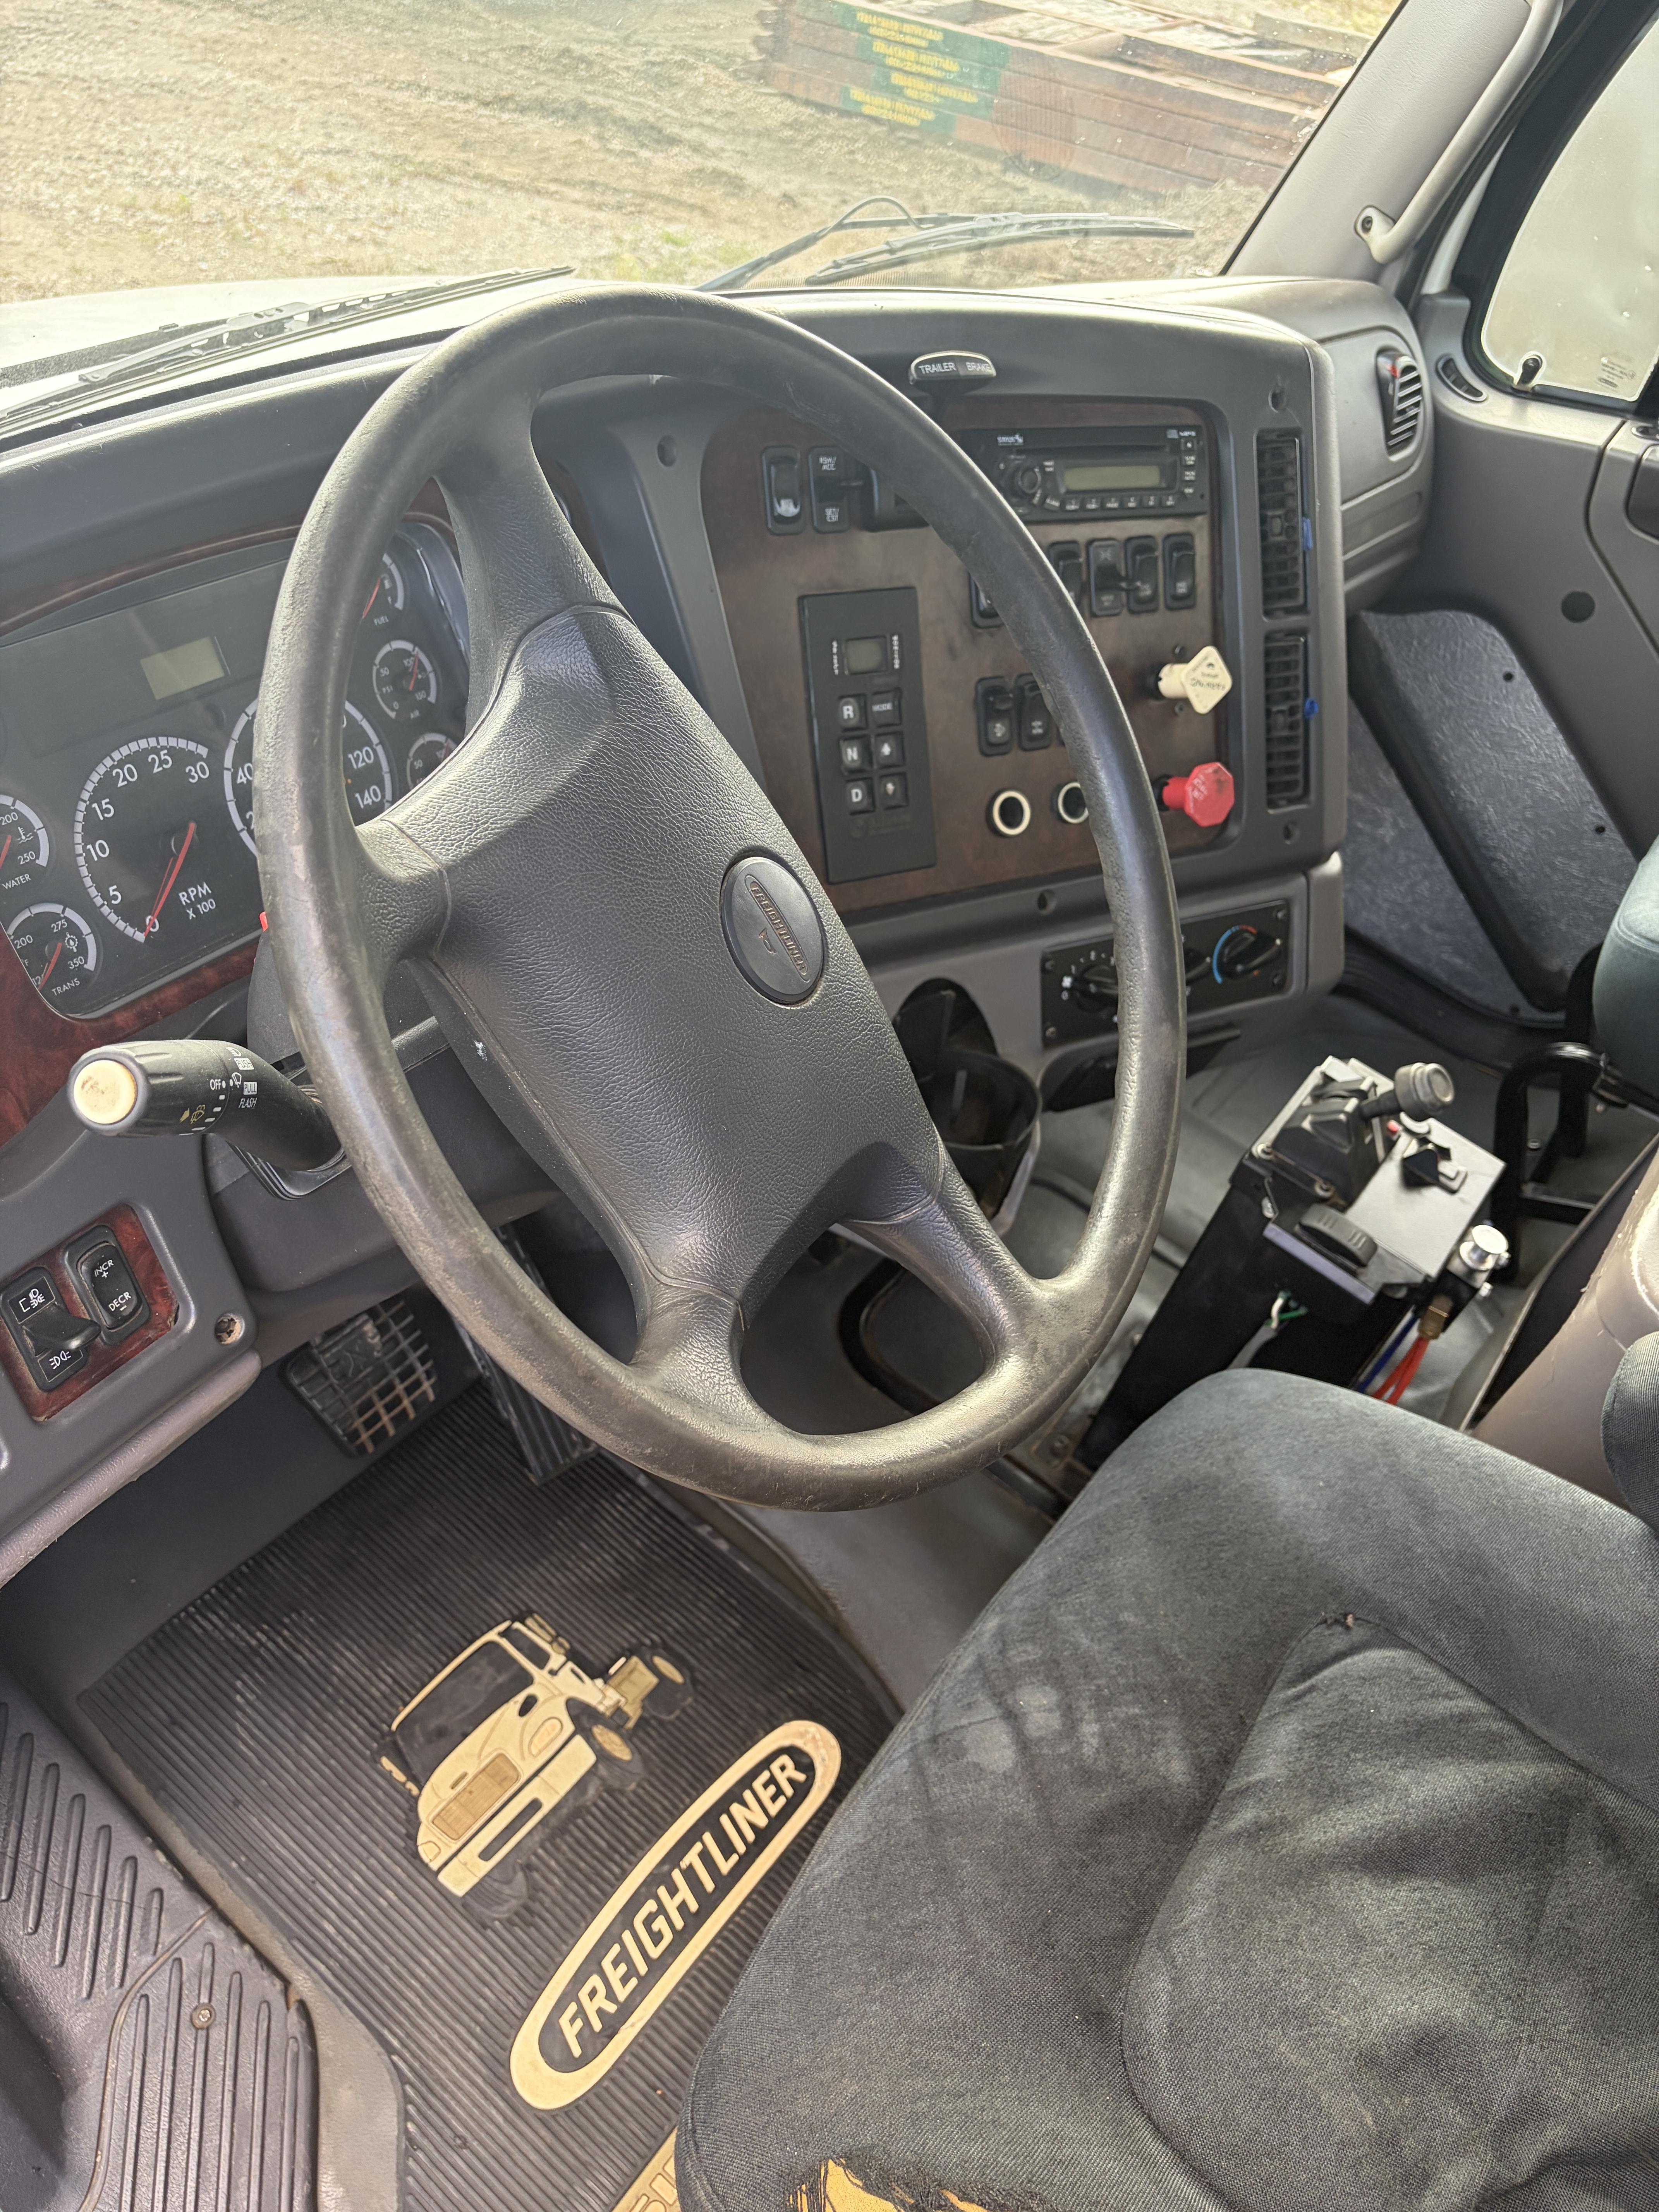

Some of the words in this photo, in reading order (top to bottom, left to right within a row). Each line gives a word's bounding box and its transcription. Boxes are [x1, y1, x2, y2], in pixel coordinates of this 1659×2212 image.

[918, 362, 957, 374] TRAILER
[966, 362, 992, 371] BRAKE
[393, 701, 399, 709] 0
[843, 705, 854, 719] R
[148, 750, 173, 774] 25
[349, 747, 374, 769] 120
[847, 747, 859, 761] N
[414, 759, 423, 769] 50
[113, 764, 138, 788] 20
[186, 762, 209, 783] 30
[236, 763, 253, 784] 40
[355, 785, 381, 809] 140
[852, 790, 862, 802] D
[92, 799, 114, 820] 15
[0, 812, 18, 826] 200
[18, 851, 35, 864] 250
[86, 840, 109, 861] 10
[2, 874, 31, 890] WATER
[109, 886, 121, 904] 5
[179, 882, 212, 905] RPM
[187, 909, 196, 920] X
[197, 899, 216, 915] 100
[51, 919, 67, 933] 275
[146, 915, 159, 932] 0
[750, 887, 807, 971] FREIGHTLINER
[14, 935, 33, 949] 200
[68, 956, 84, 969] 350
[32, 974, 44, 986] 12
[52, 978, 80, 996] TRANS
[236, 1059, 253, 1069] PUSH
[210, 1079, 221, 1090] OFF
[244, 1083, 257, 1093] PULL
[239, 1097, 257, 1108] FLASH
[94, 1259, 114, 1277] INCR
[108, 1291, 132, 1312] DECR
[558, 1754, 807, 2058] FREIGHTLINER
